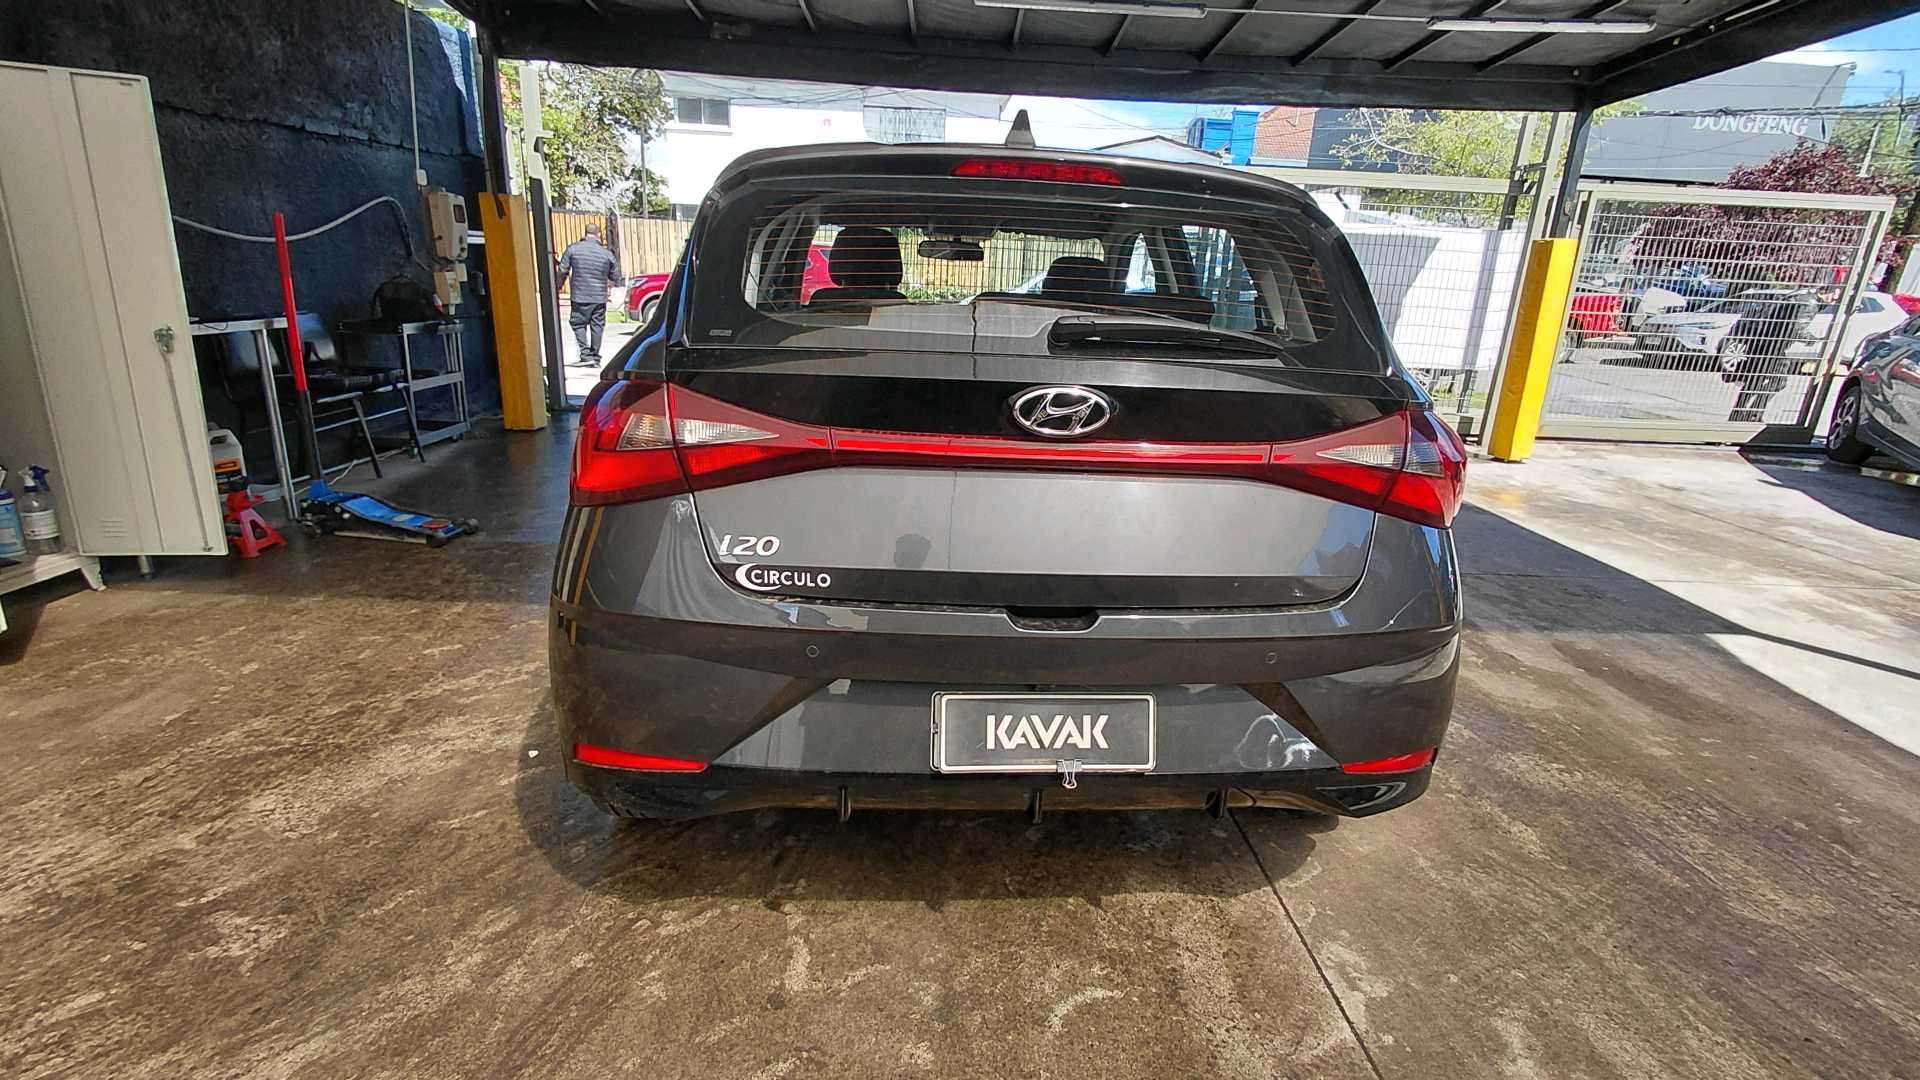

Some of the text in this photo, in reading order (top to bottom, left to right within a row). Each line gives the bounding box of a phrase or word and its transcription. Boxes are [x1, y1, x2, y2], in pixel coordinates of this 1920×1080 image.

[1692, 114, 1808, 136] DONGFENG
[749, 568, 832, 588] CIRCULO
[986, 714, 1109, 750] KAVAK
